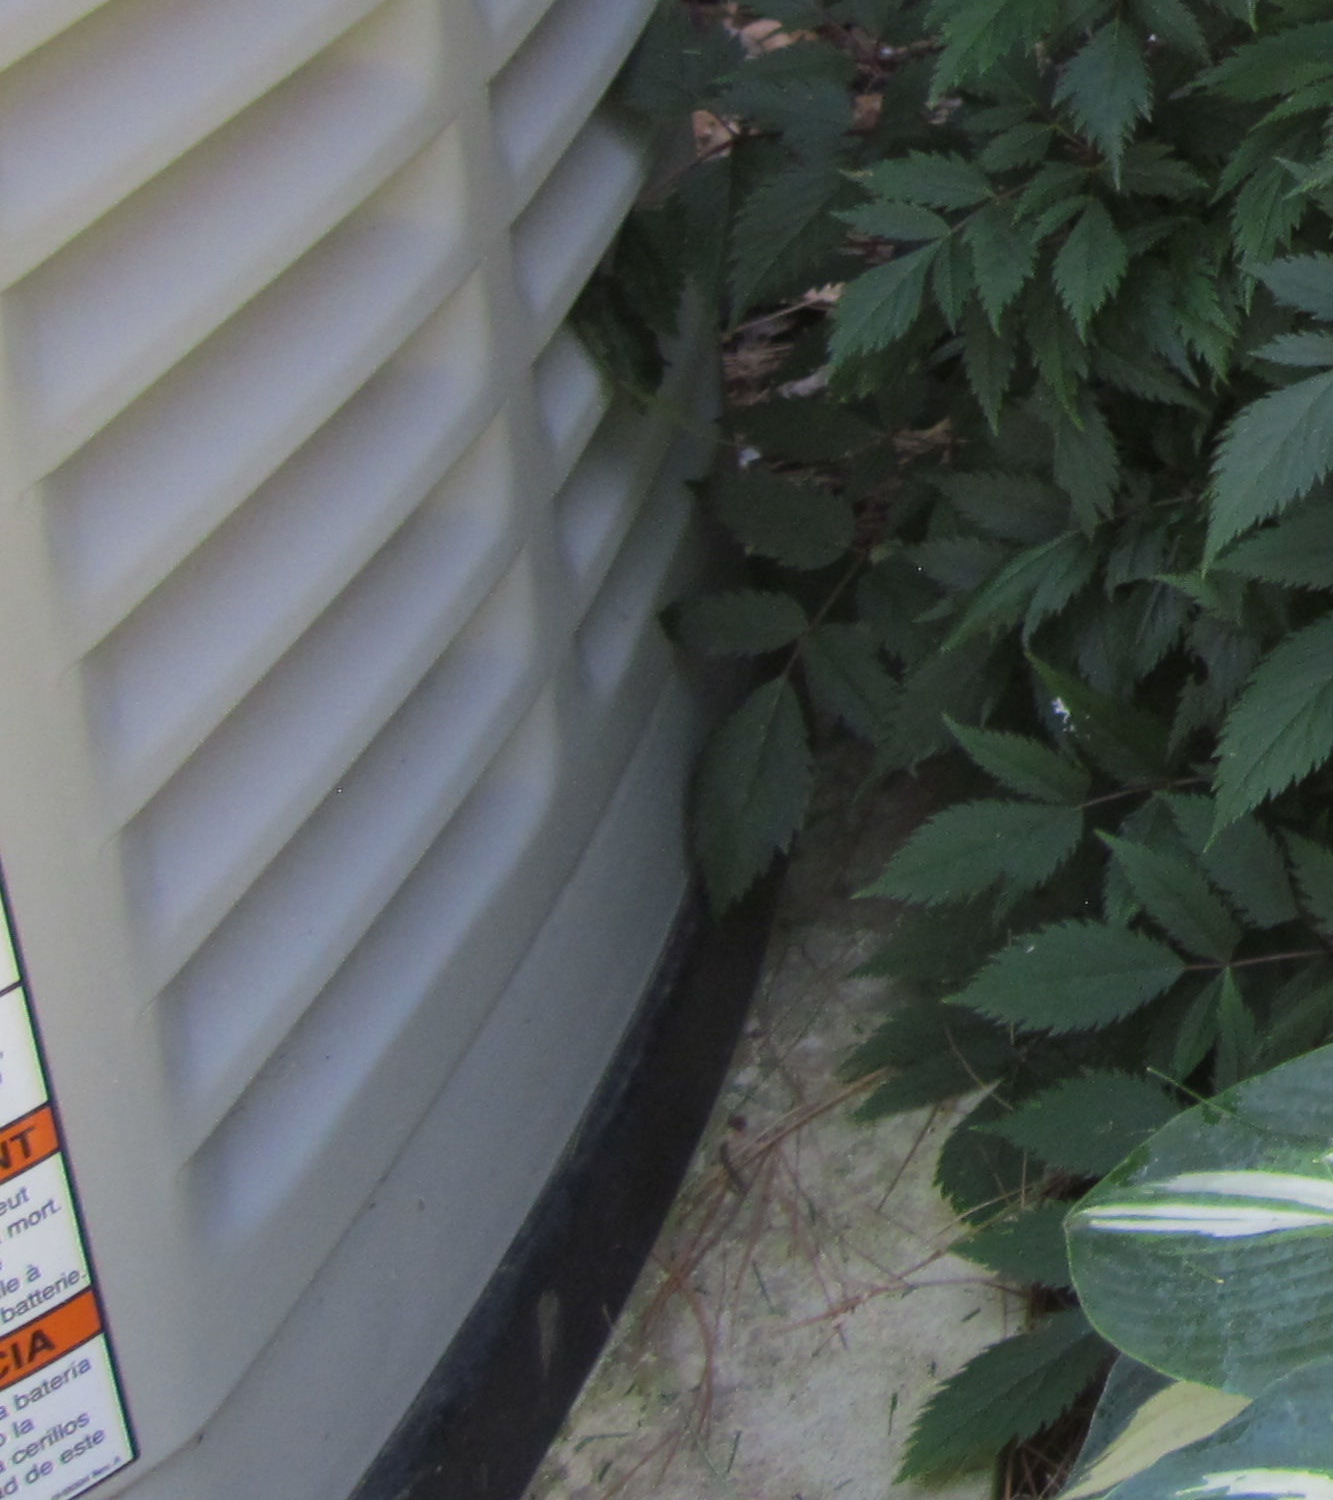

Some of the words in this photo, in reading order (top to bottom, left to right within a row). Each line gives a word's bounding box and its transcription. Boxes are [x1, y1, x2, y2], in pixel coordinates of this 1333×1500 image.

[12, 1418, 34, 1438] la
[12, 1412, 90, 1465] cerillos
[25, 1460, 53, 1485] de
[60, 1429, 105, 1464] este
